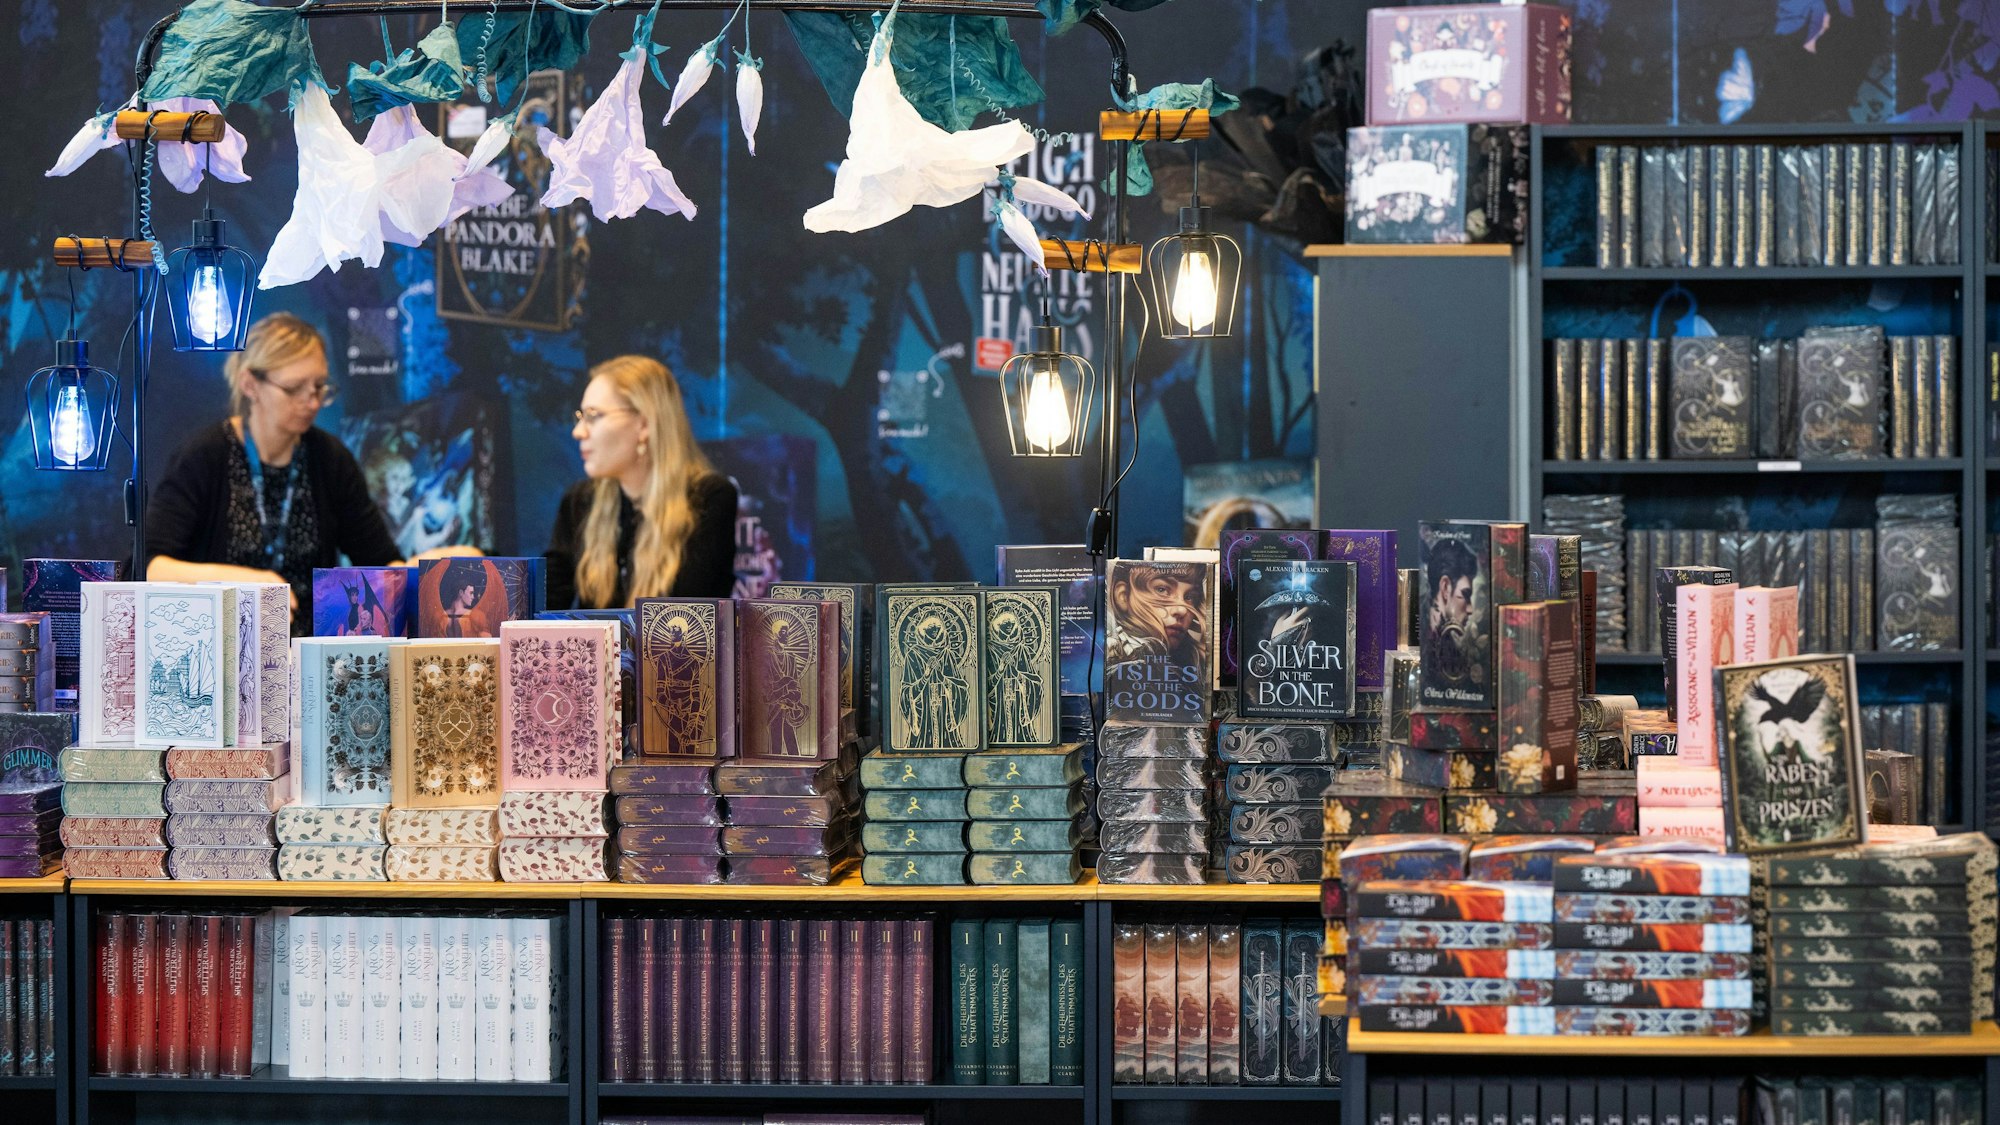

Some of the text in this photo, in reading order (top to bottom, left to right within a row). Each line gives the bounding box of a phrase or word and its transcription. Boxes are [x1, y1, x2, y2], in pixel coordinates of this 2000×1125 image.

[444, 221, 556, 248] PANDORA
[460, 249, 536, 275] BLAKE
[1685, 608, 1697, 651] VILLAIN
[1744, 612, 1756, 656] VILLAIN
[1144, 654, 1172, 665] THE
[1247, 639, 1343, 678] SILVER
[1116, 664, 1199, 683] ISLES
[1279, 671, 1313, 682] IN THE
[1131, 682, 1183, 692] OF THE
[1258, 681, 1334, 708] BONE
[1113, 691, 1201, 711] GODS
[3, 750, 53, 774] GLIMMER
[819, 973, 828, 995] BUCH
[851, 974, 859, 996] BUCH
[883, 974, 891, 996] BUCH
[913, 973, 923, 996] BUCH
[788, 971, 796, 1056] DIE ROTEN SCHRIFTROLLEN
[959, 981, 970, 1032] GEHEIMNISSE
[968, 967, 979, 1044] SCHATTENMARKTES
[992, 980, 1002, 1032] GEHEIMNISSE
[1000, 968, 1012, 1044] SCHATTENMARKTES
[1058, 963, 1069, 1048] DIE GEHEIMNISSE DES
[1067, 968, 1077, 1044] SCHATTENMARKTES
[819, 1038, 828, 1053] DAS
[850, 1038, 859, 1053] DAS
[882, 1039, 891, 1054] DAS
[913, 1038, 923, 1053] DAS
[960, 1034, 968, 1048] DIE
[992, 1034, 1000, 1048] DIE
